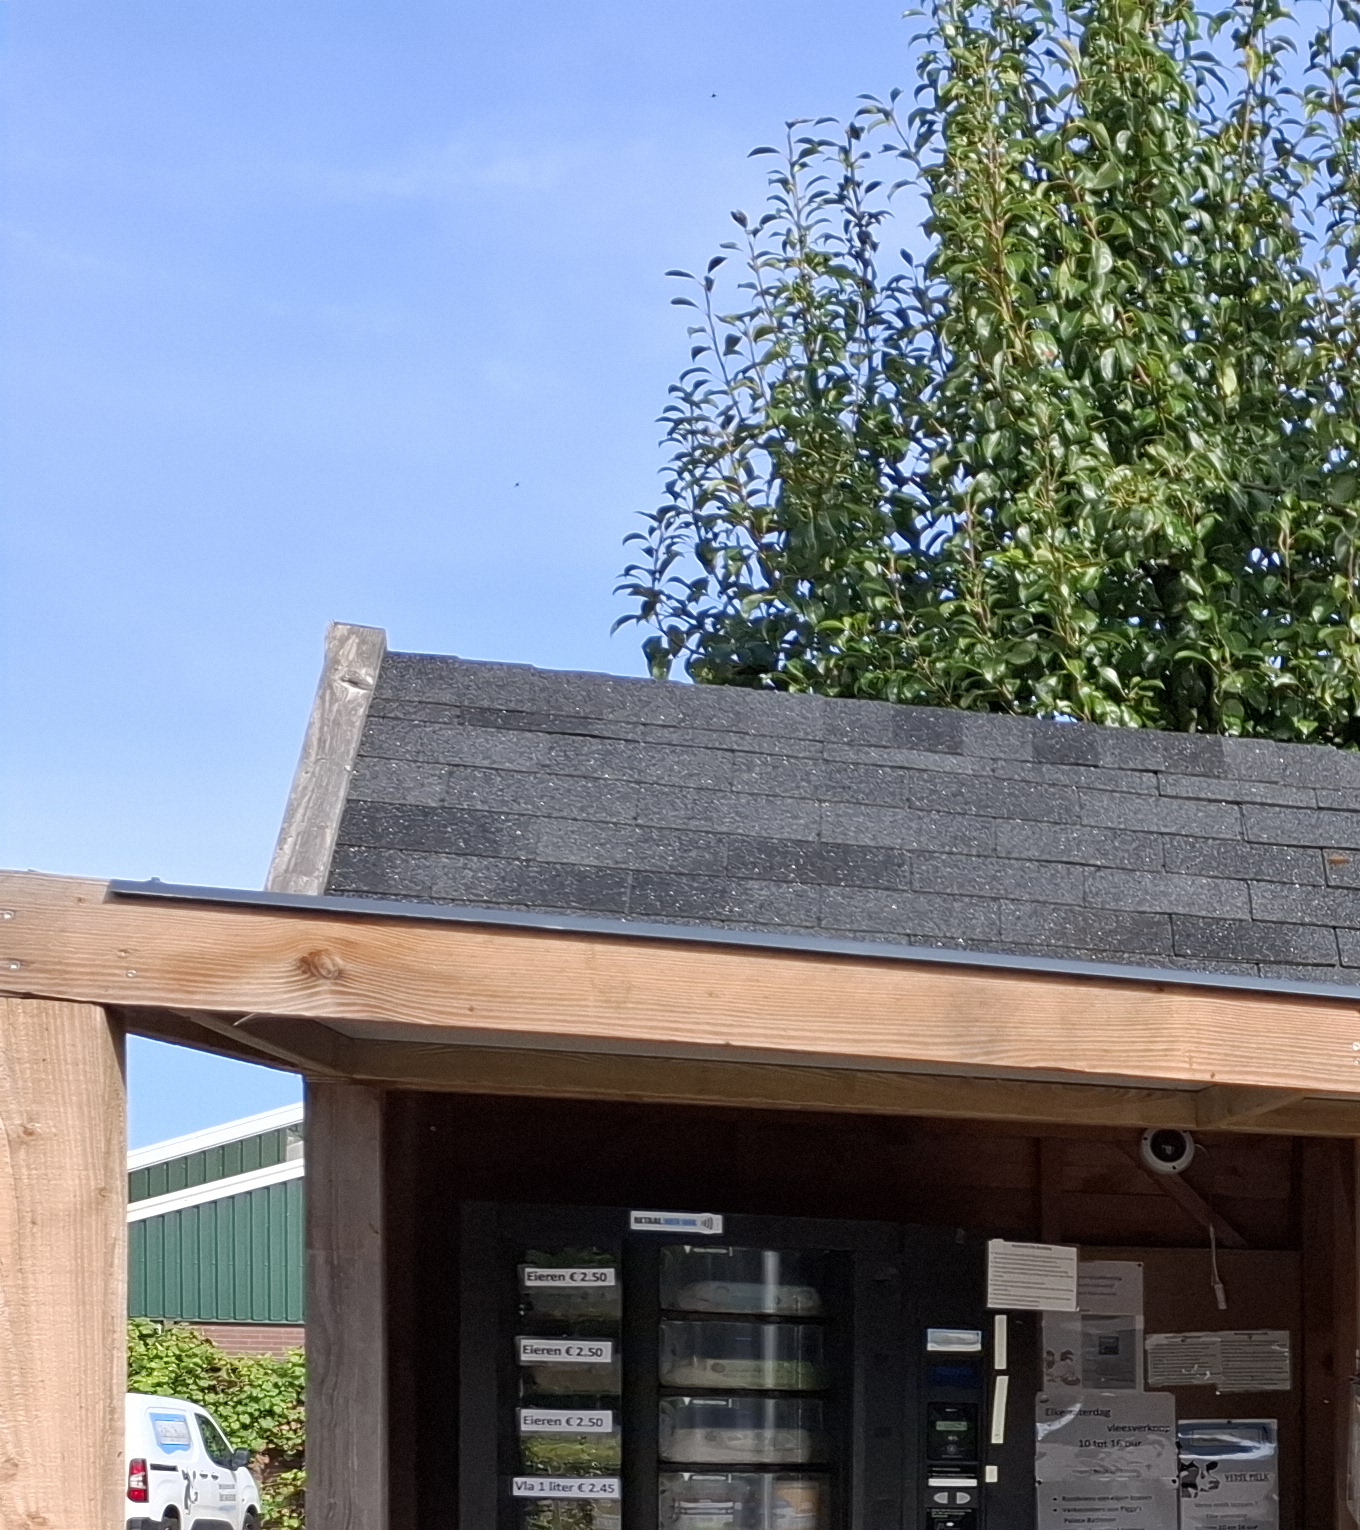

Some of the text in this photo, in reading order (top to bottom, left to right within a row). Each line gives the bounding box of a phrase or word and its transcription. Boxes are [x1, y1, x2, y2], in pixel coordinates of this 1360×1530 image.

[527, 1271, 566, 1282] Eieren
[580, 1272, 608, 1283] 2.50
[522, 1344, 562, 1357] Eieren
[576, 1347, 604, 1358] 2.50
[523, 1416, 562, 1427] Eieren
[576, 1417, 604, 1428] 2.50
[515, 1481, 534, 1491] Vla
[549, 1481, 574, 1493] liter
[588, 1483, 615, 1494] 2.45
